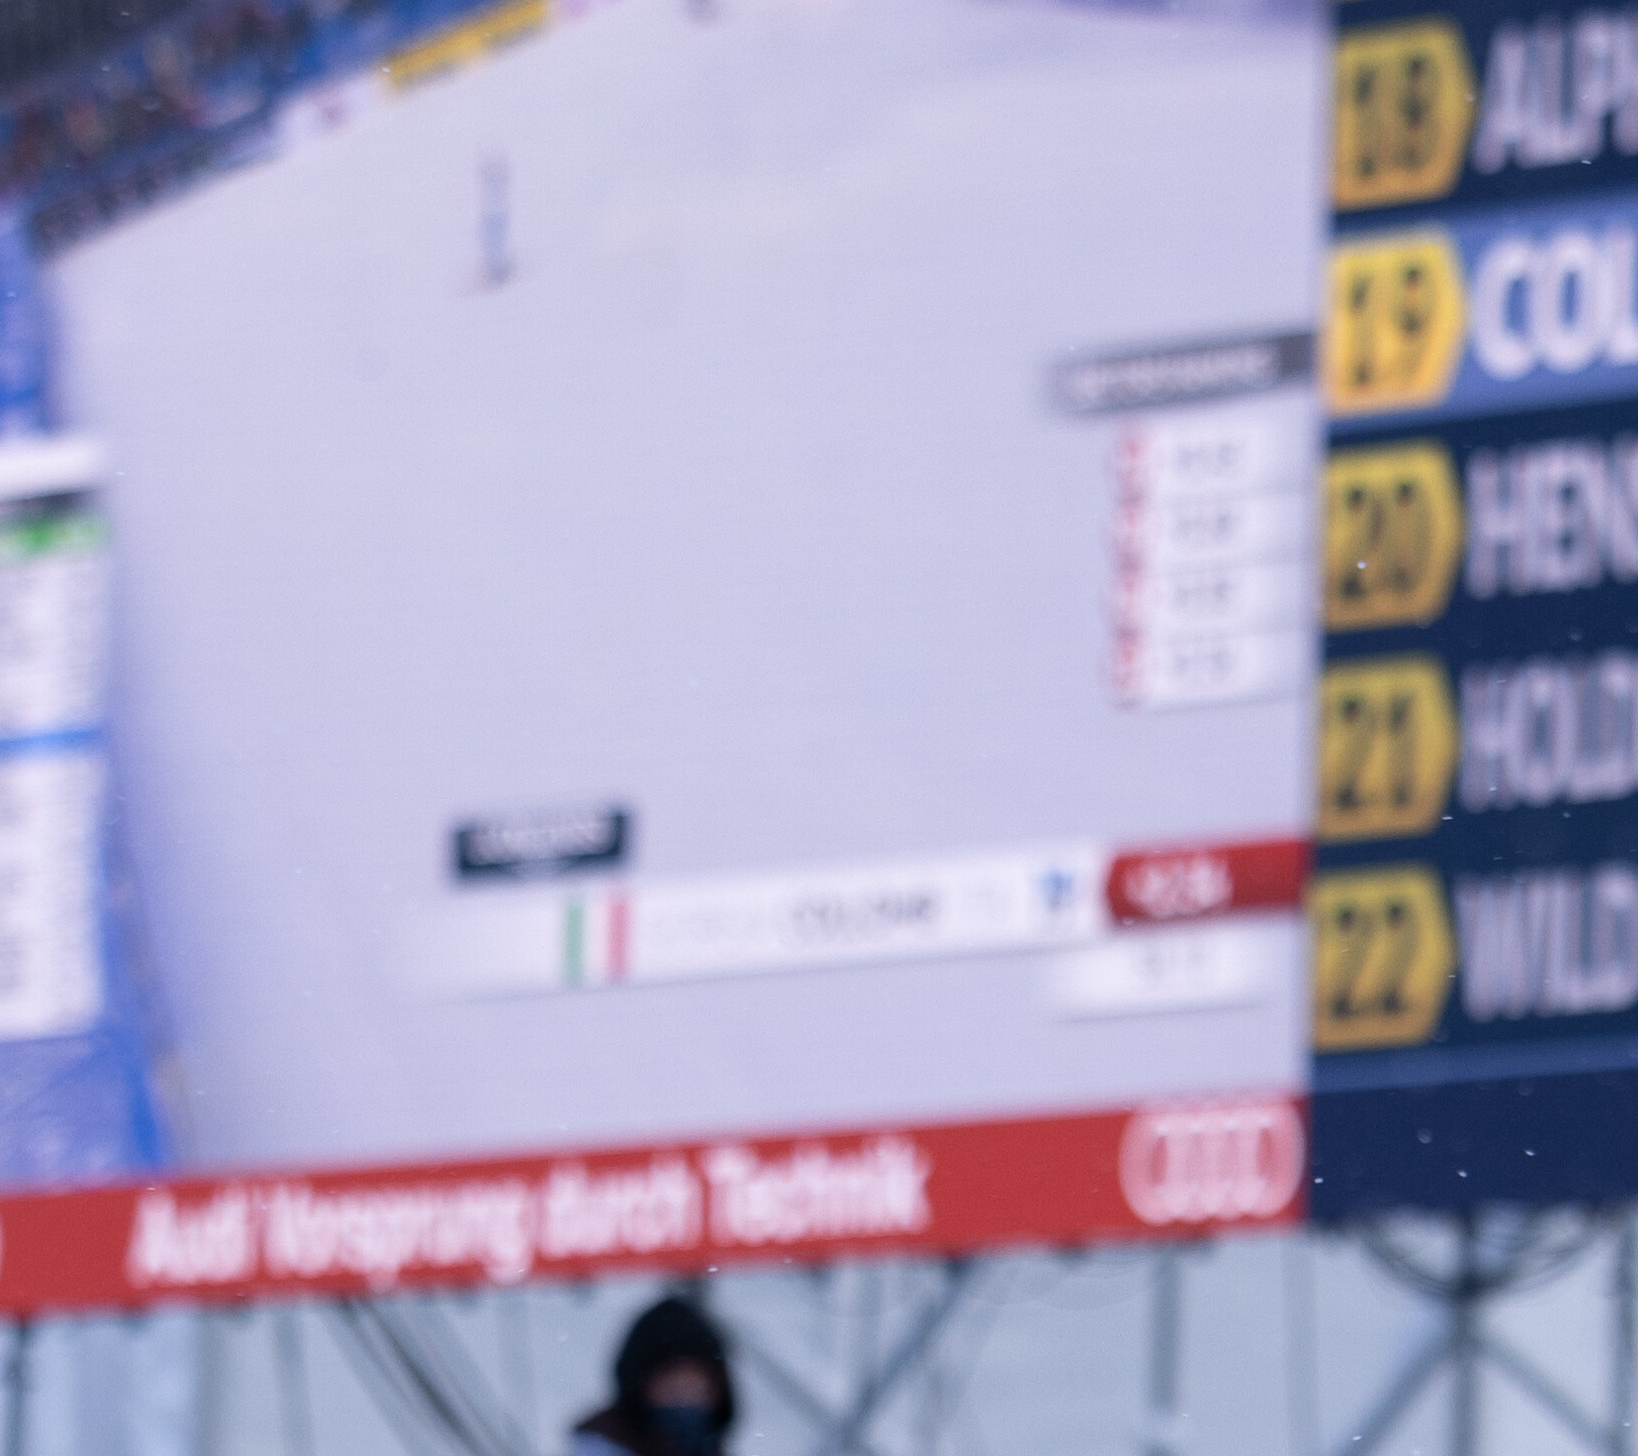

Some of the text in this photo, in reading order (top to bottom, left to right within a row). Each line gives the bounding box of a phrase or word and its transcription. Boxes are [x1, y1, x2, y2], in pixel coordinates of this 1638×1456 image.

[128, 1194, 250, 1288] Audi
[539, 1151, 700, 1261] durch
[707, 1136, 930, 1245] Technik
